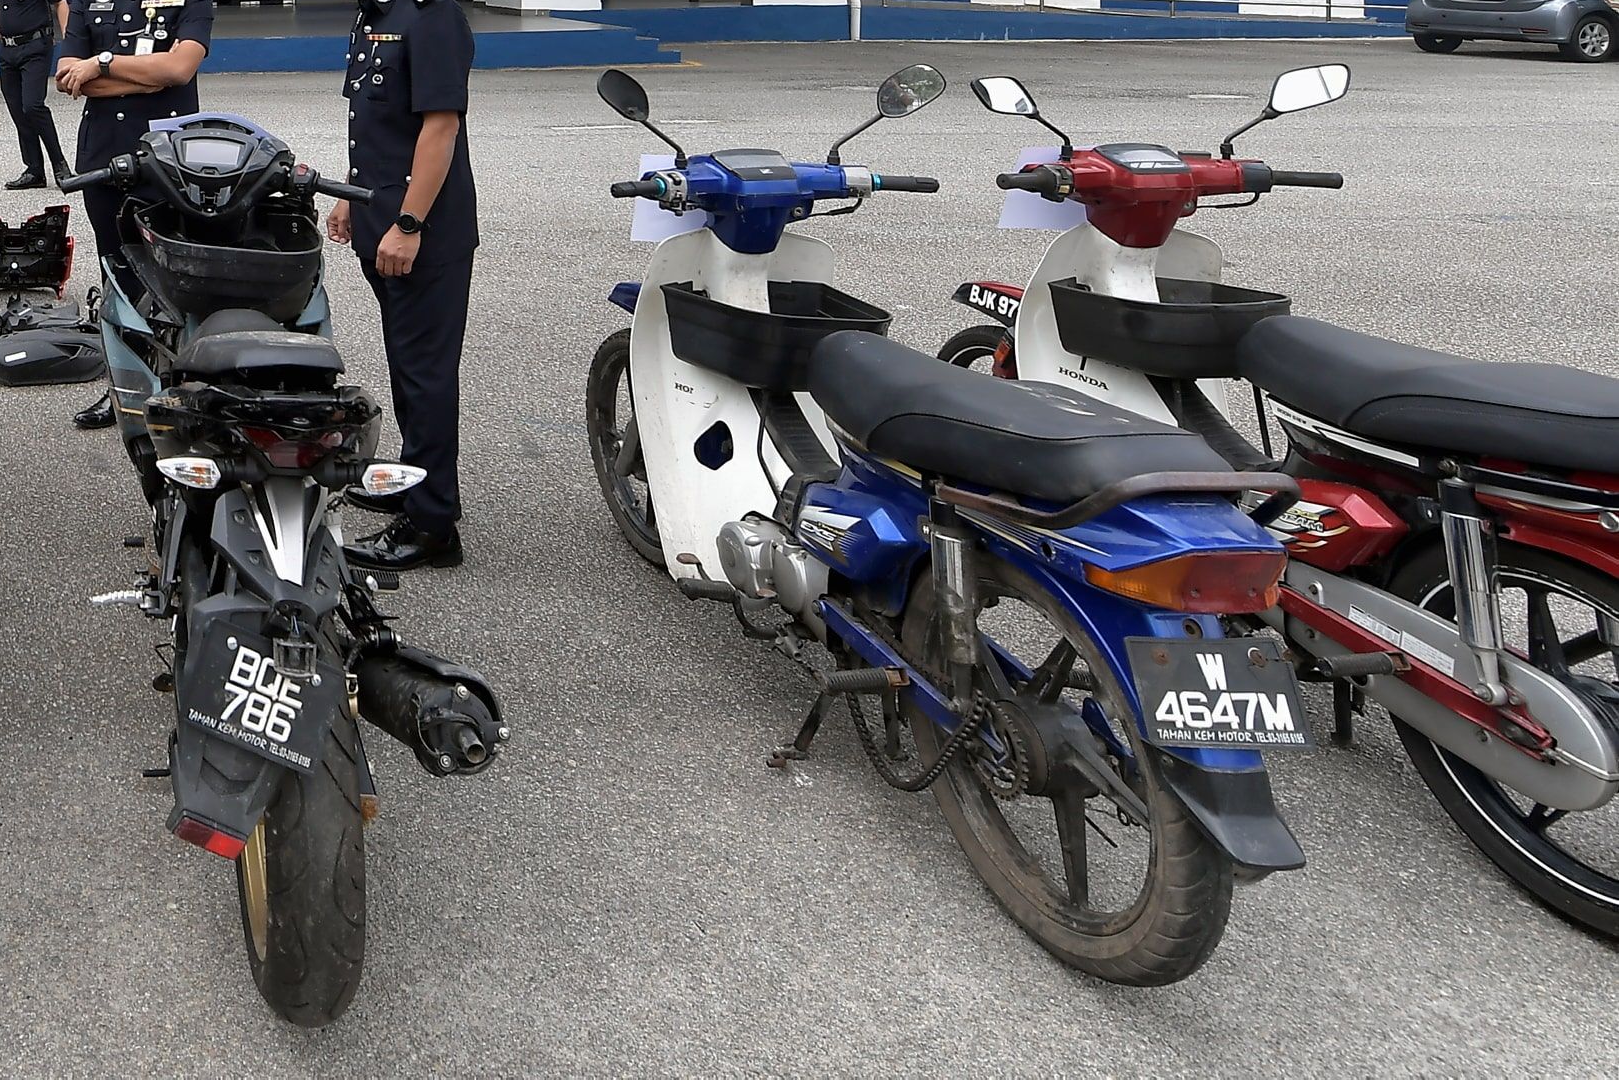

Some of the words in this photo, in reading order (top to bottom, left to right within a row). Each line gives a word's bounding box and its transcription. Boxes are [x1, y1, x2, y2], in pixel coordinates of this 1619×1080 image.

[969, 284, 998, 311] BJK
[1057, 366, 1110, 391] HONDA
[229, 645, 303, 710] BQE
[1195, 653, 1228, 691] W
[188, 708, 220, 729] TAMAN
[217, 719, 239, 738] KEM
[237, 730, 269, 751] MOTOR
[220, 681, 297, 743] 786
[1155, 690, 1295, 731] 4647M
[1156, 728, 1192, 740] TAMAN
[1194, 729, 1216, 741] KEM
[1217, 730, 1253, 743] MOTOR
